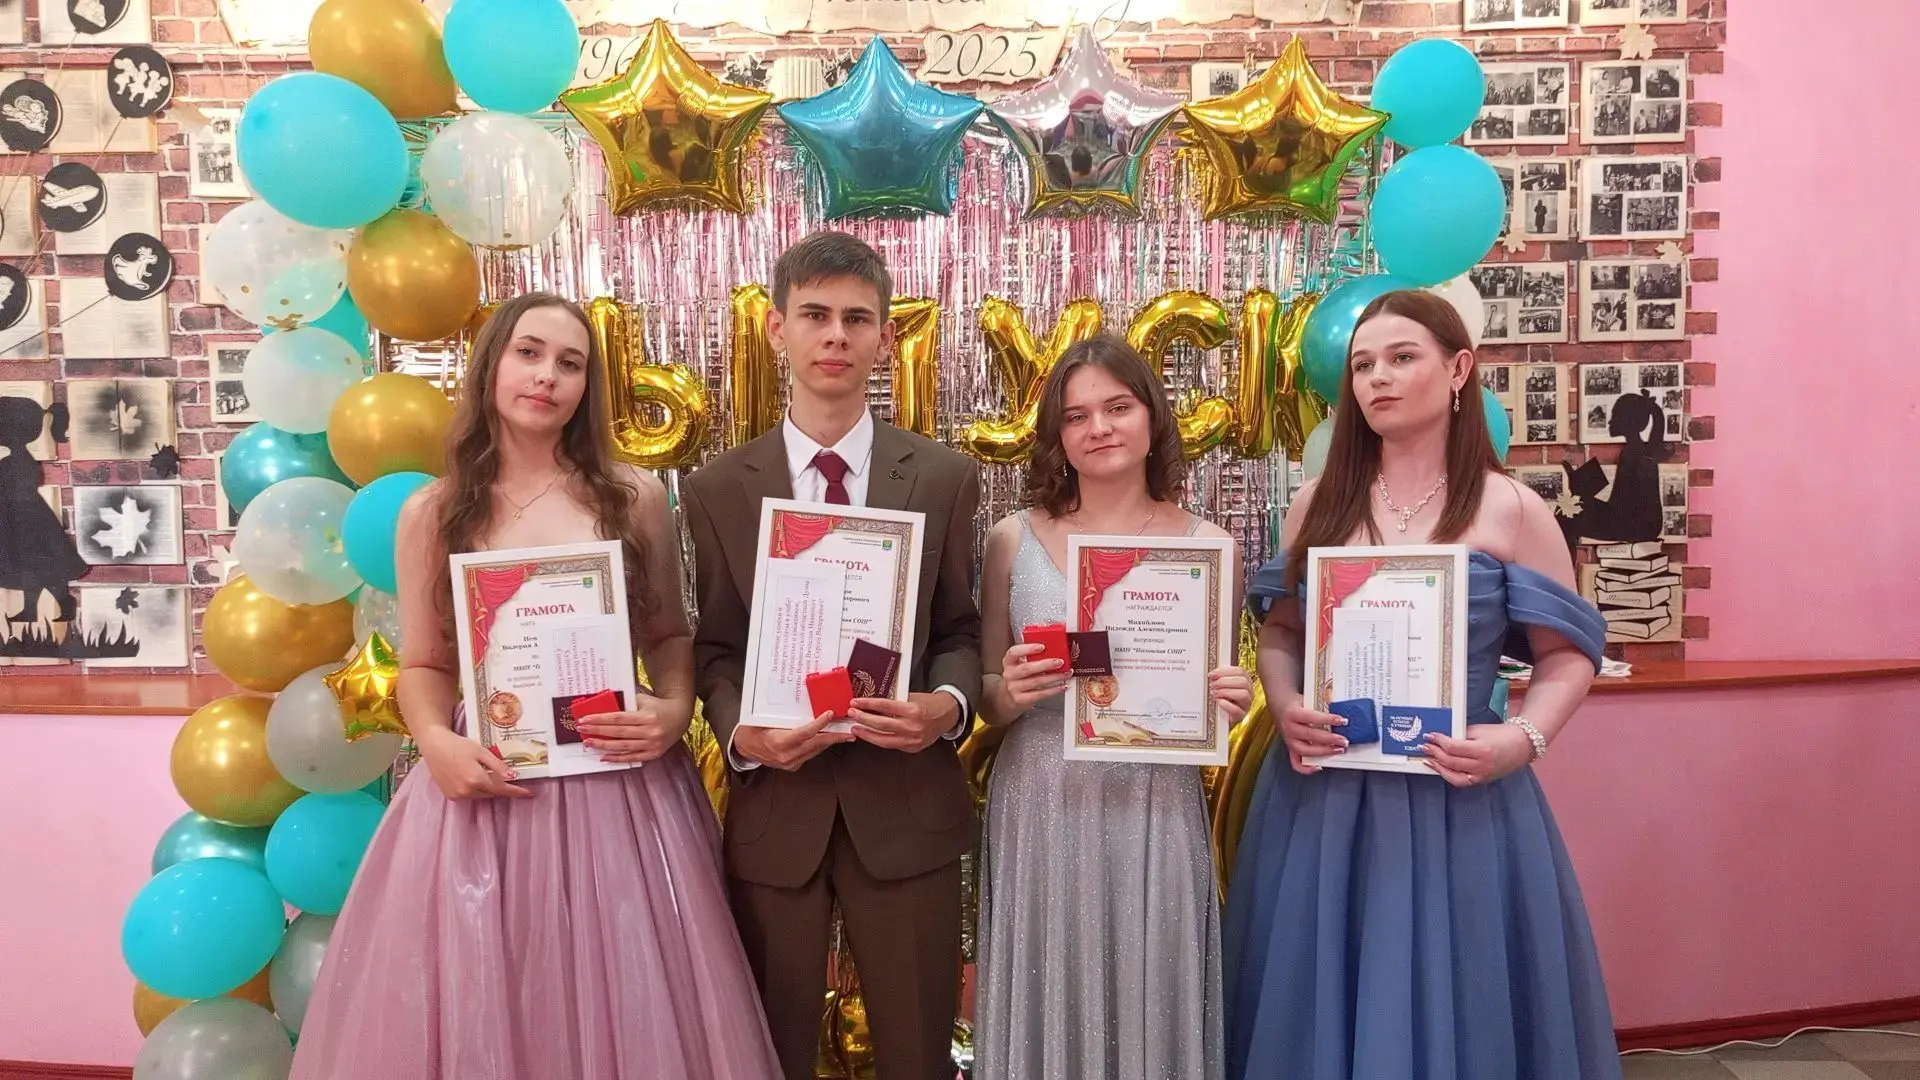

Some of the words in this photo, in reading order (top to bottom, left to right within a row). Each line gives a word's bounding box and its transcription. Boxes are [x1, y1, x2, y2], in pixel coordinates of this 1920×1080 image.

[573, 36, 640, 79] 196
[924, 33, 1045, 77] 2025
[1123, 591, 1180, 601] ГРАМОТА
[516, 604, 575, 617] ГРАМОТА
[1360, 600, 1415, 609] ГРАМОТА
